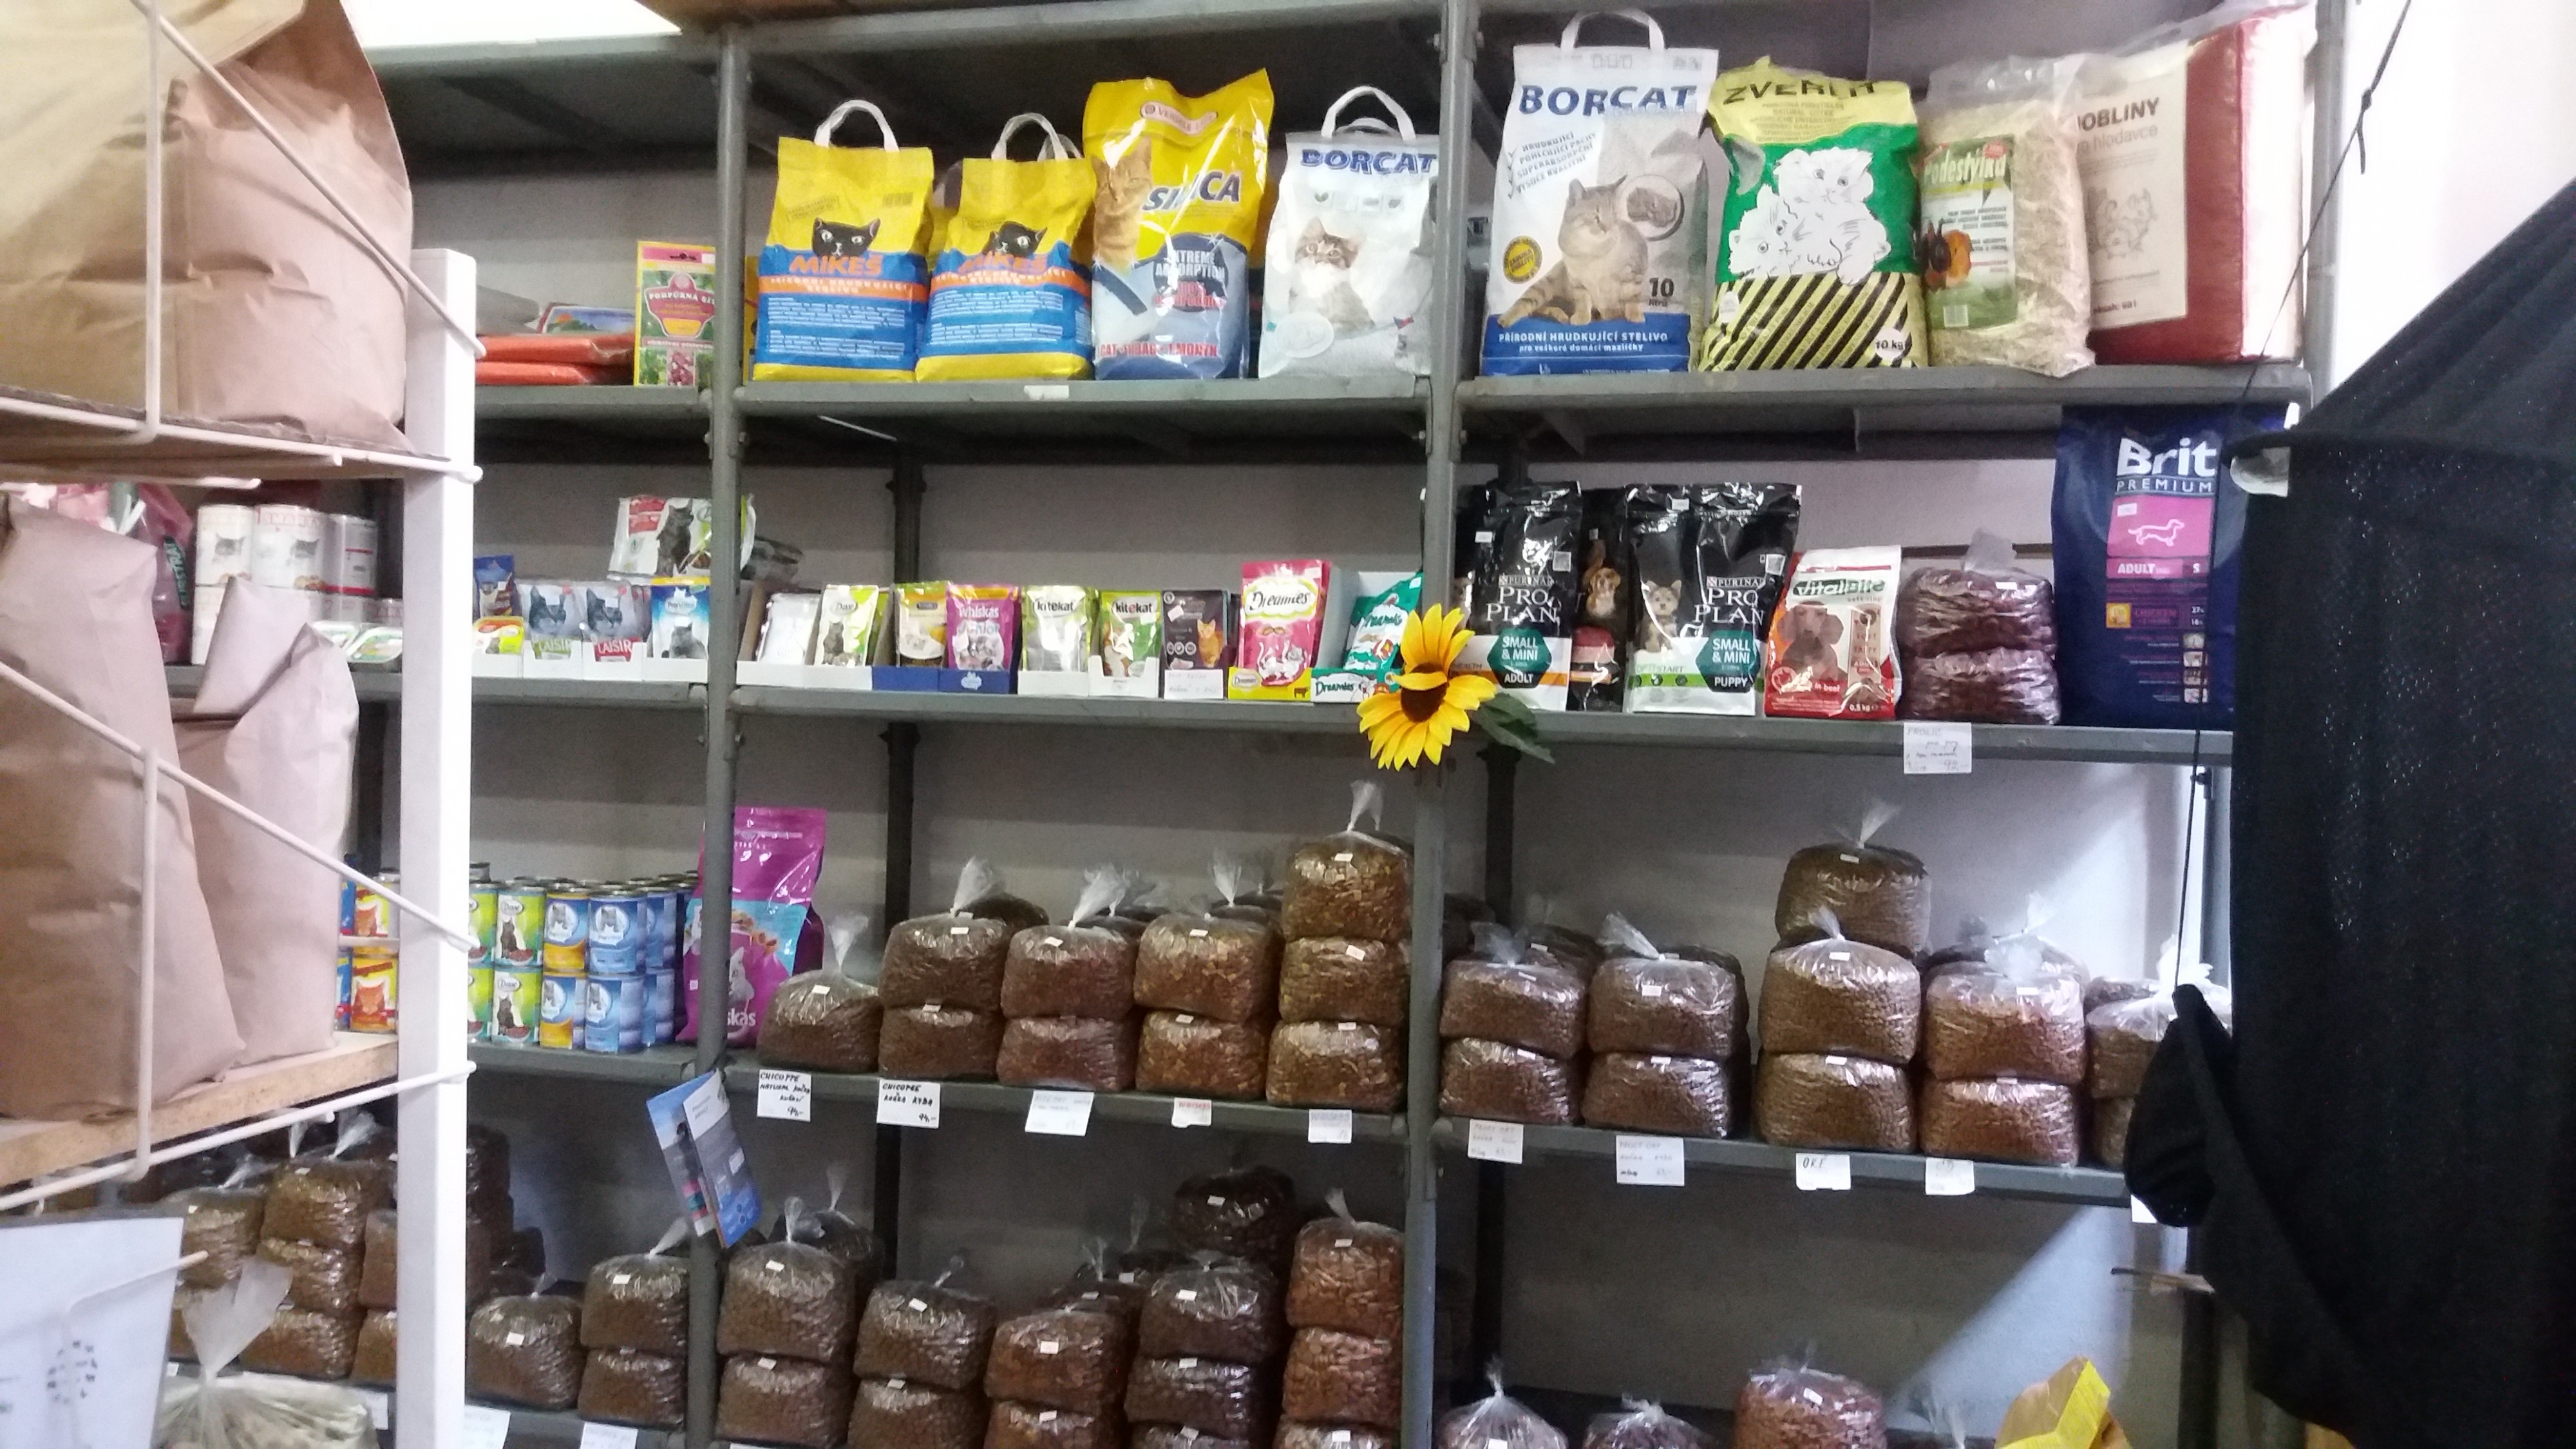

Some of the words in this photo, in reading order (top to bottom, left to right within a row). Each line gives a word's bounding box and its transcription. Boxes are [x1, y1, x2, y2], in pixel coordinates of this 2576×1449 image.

[1519, 85, 1697, 117] BORCAT
[1301, 149, 1437, 175] BORCAT
[789, 254, 883, 276] MIKES
[1649, 278, 1674, 298] 10
[1549, 330, 1618, 343] HRUDKUJÍCÍ
[1622, 332, 1668, 343] STELIVO
[2117, 437, 2217, 477] Brit
[2116, 478, 2211, 493] PREMIUM
[2117, 563, 2155, 574] ADULT
[1718, 578, 1759, 587] PURINA
[1250, 591, 1311, 611] Dreamies
[1499, 586, 1548, 605] PRO
[1707, 587, 1759, 607] PRO
[1037, 601, 1074, 612] kitekat
[1115, 602, 1153, 614] kitekat
[1486, 603, 1558, 624] PLAN
[1693, 604, 1765, 626] PLAN
[1502, 636, 1539, 649] SMALL
[1712, 638, 1750, 652] SMALL
[1501, 649, 1511, 660] &
[1513, 649, 1538, 661] MINI
[1712, 651, 1722, 663] &
[1724, 652, 1750, 664] MINI
[1504, 672, 1534, 683] ADULT
[1714, 676, 1748, 688] PUPPY
[728, 1007, 756, 1027] skas
